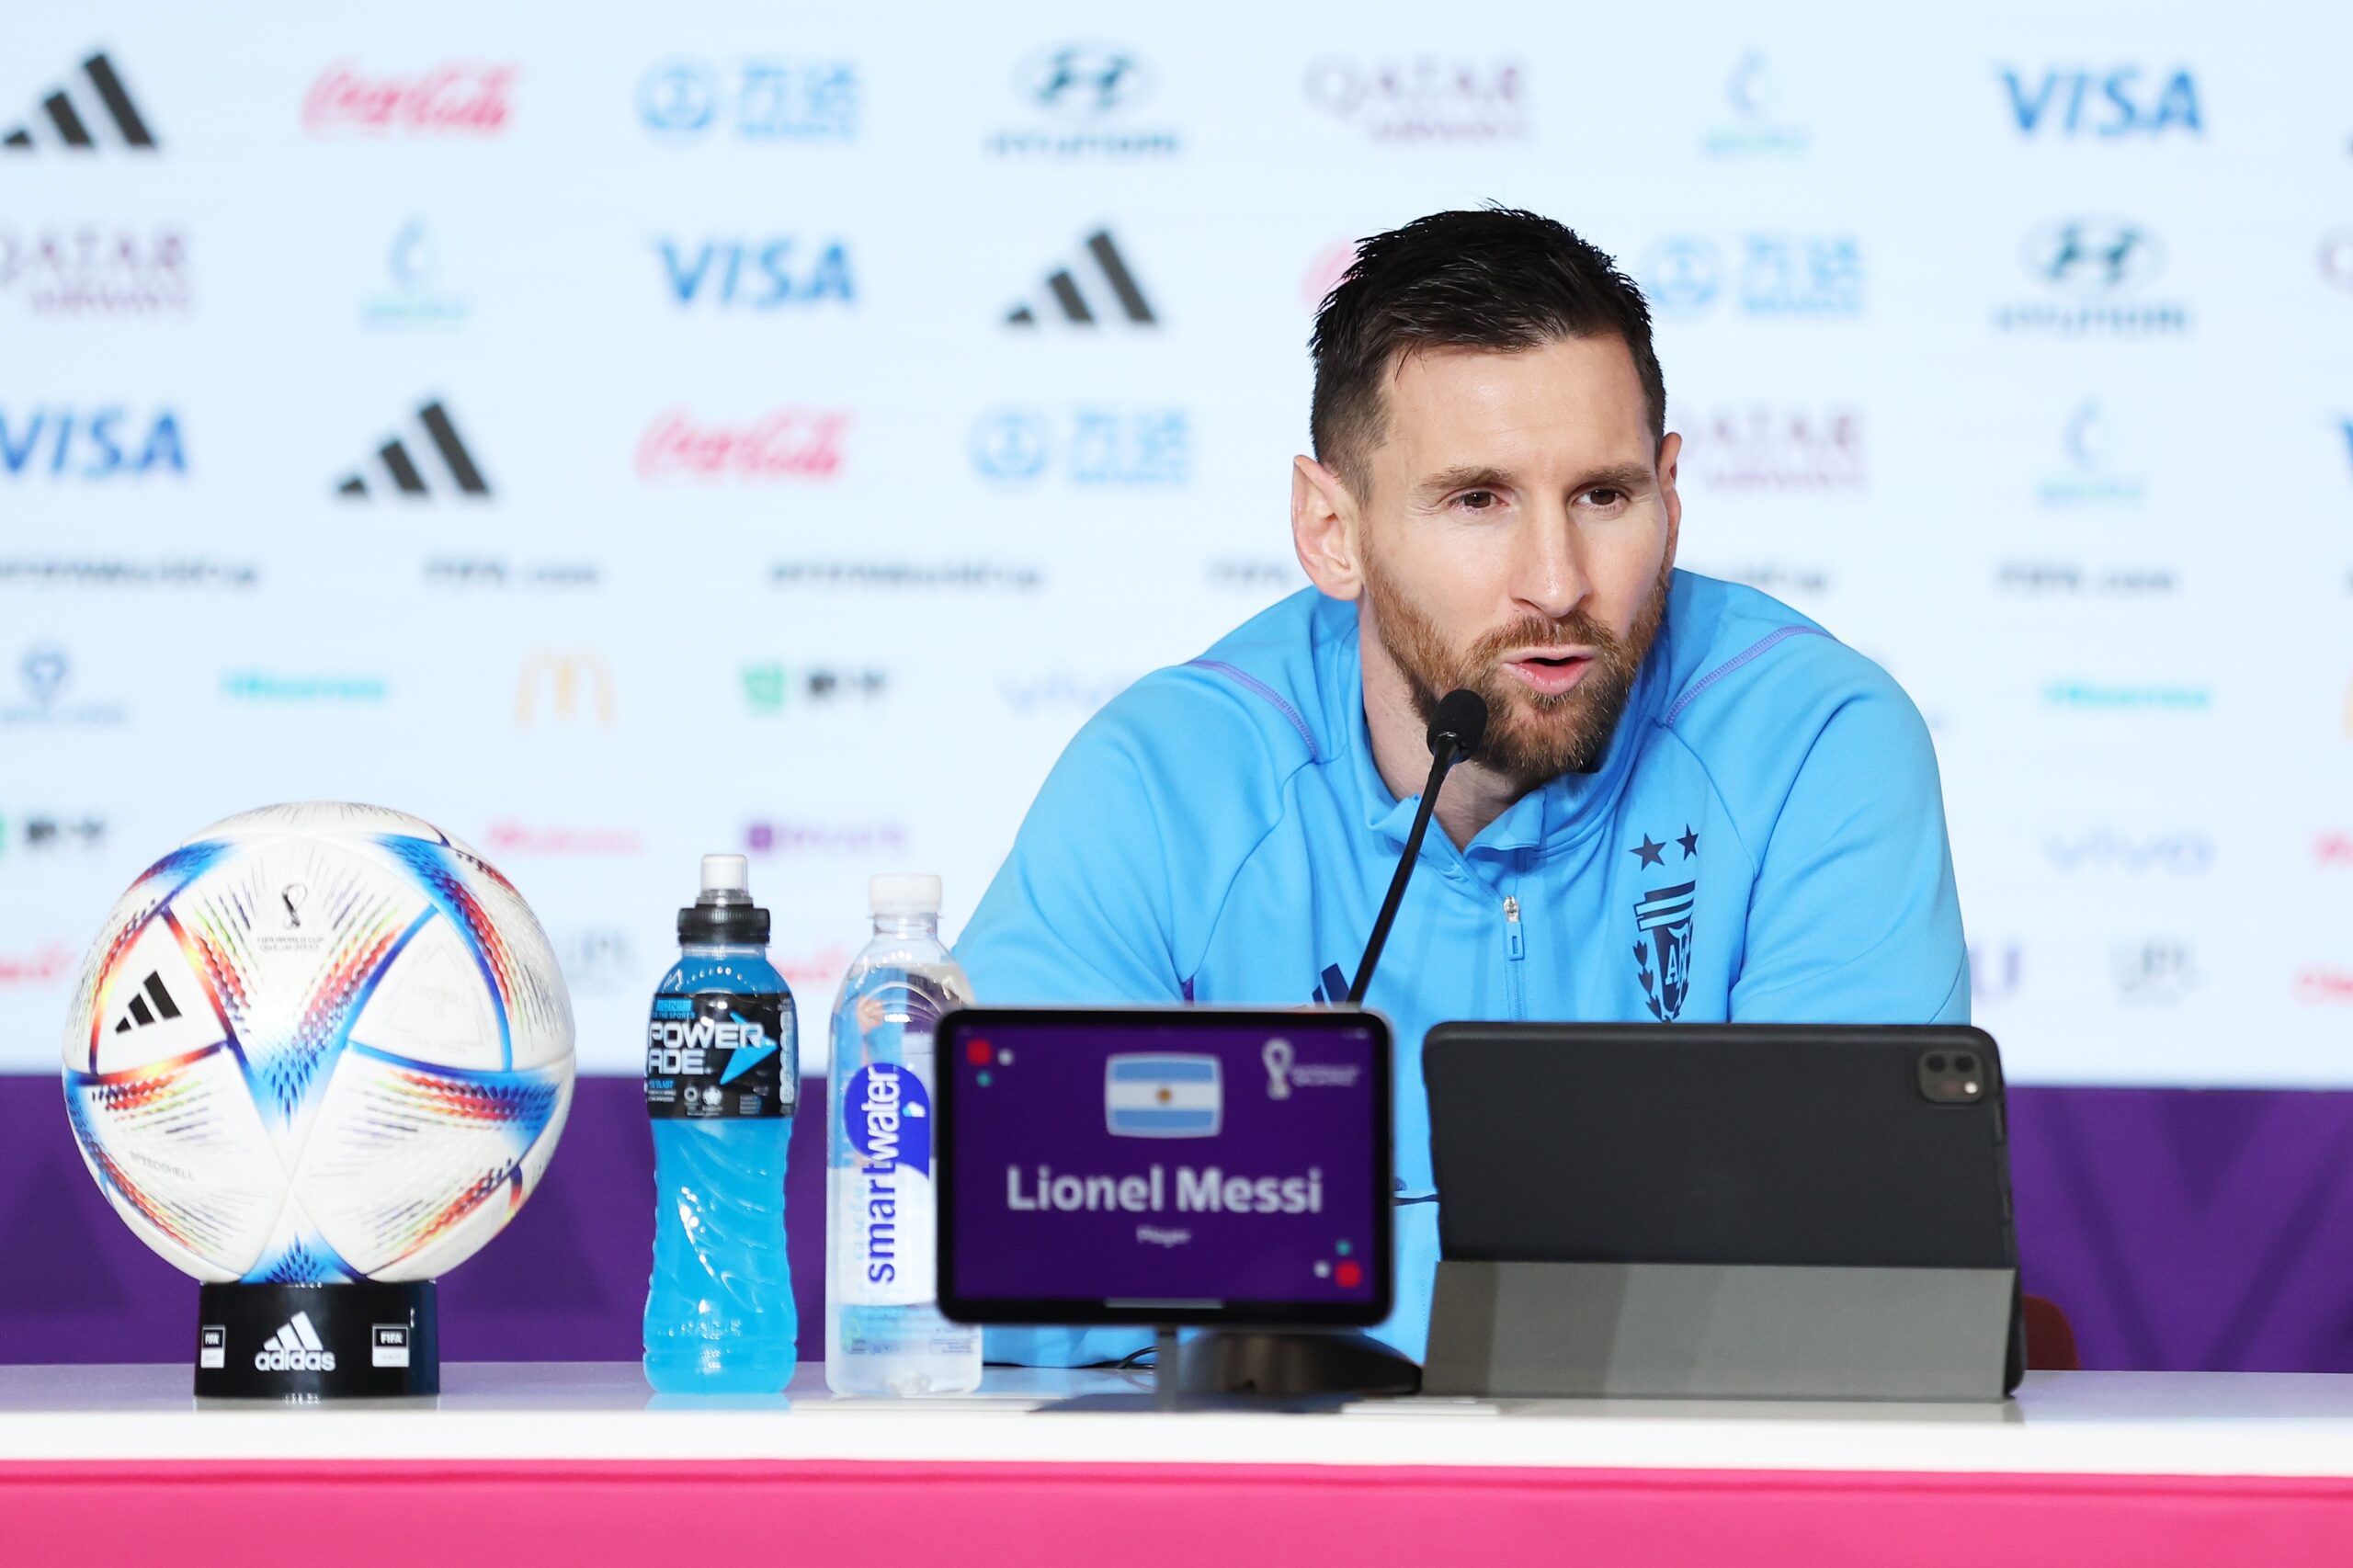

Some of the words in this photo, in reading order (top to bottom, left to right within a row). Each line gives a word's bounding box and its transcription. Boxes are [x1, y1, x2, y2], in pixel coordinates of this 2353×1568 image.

[1996, 65, 2204, 136] VISA
[656, 236, 857, 306] VISA
[0, 404, 187, 477] VISA
[649, 1021, 765, 1049] POWER
[861, 1064, 903, 1283] smartwater
[1007, 1163, 1164, 1210] Lionel
[1176, 1165, 1323, 1213] Messi
[255, 1350, 336, 1371] adidas
[381, 1331, 404, 1345] FIFA
